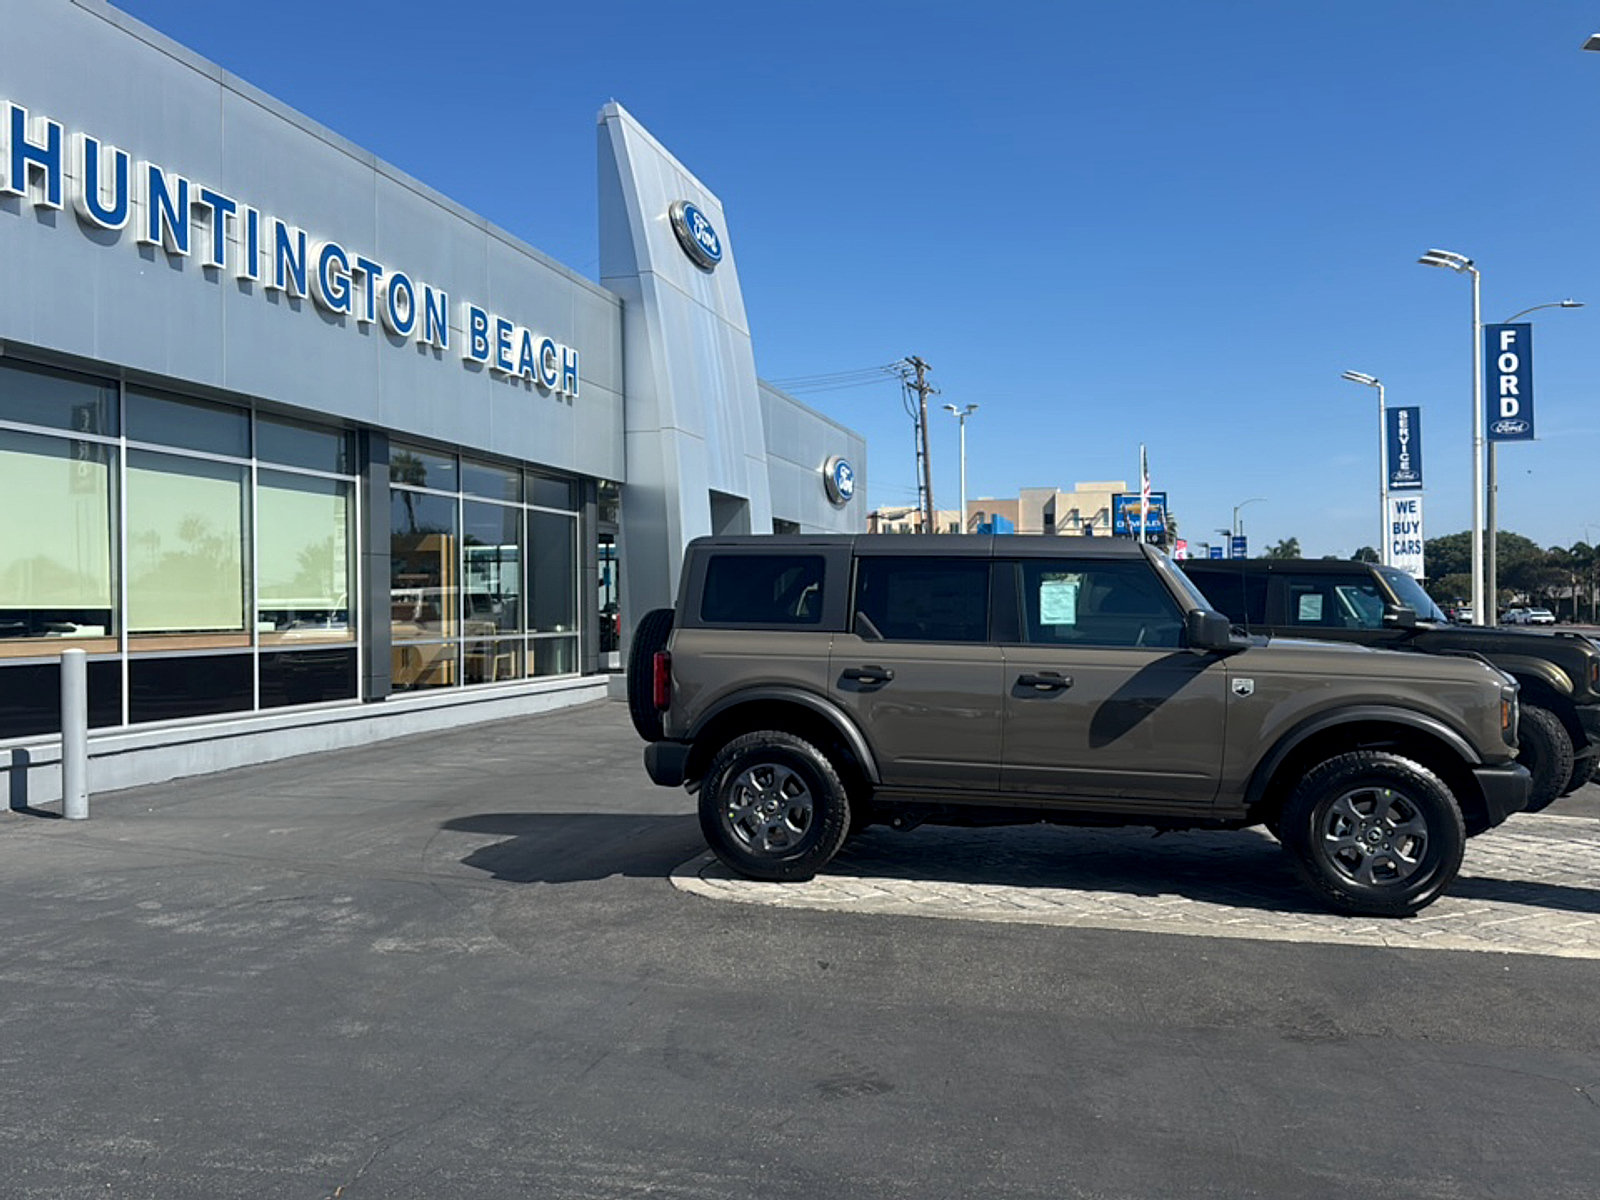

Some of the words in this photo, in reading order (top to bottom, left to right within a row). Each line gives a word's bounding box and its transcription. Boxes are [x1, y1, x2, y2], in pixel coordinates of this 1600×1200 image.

[690, 209, 719, 255] Ford
[4, 100, 449, 350] HUNTINGTON
[464, 302, 579, 398] BEACH
[1498, 330, 1519, 417] FORD
[1398, 410, 1409, 470] SERVICE
[1495, 421, 1525, 434] Ford
[837, 464, 853, 495] Ford
[1395, 500, 1416, 514] WE
[1393, 520, 1419, 535] BUY
[1393, 540, 1421, 555] CARS
